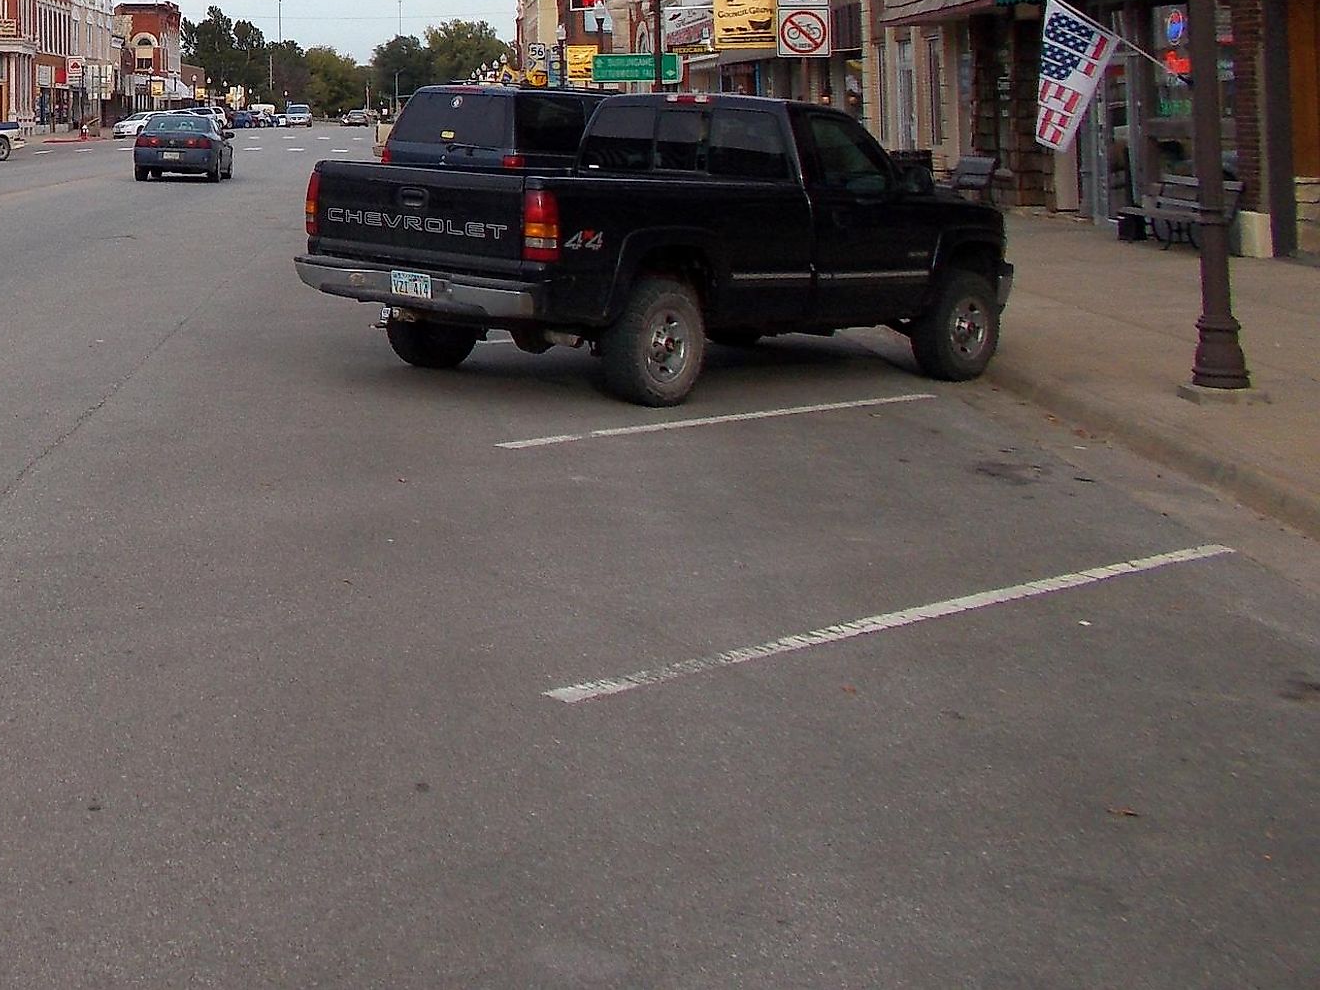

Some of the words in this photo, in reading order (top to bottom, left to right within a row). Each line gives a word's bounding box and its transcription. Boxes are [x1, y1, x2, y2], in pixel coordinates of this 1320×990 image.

[717, 9, 749, 18] COUNCIL
[530, 47, 544, 56] 56
[327, 207, 508, 240] CHEVROLET
